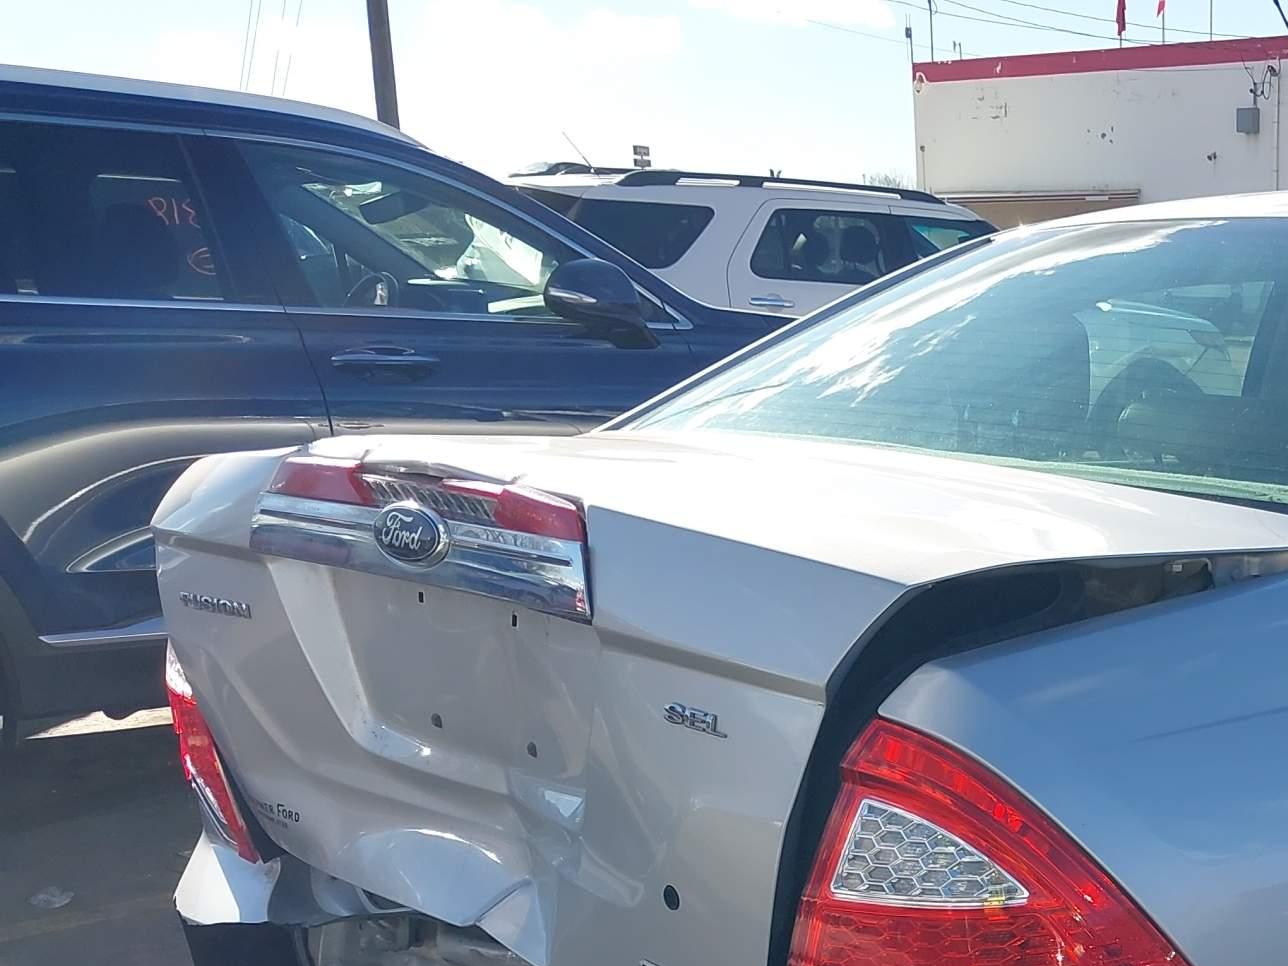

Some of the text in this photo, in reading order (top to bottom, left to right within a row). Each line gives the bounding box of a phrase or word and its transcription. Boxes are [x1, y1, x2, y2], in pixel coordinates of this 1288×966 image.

[382, 511, 422, 551] Ford
[180, 591, 252, 619] FUSION
[663, 702, 728, 738] SEL
